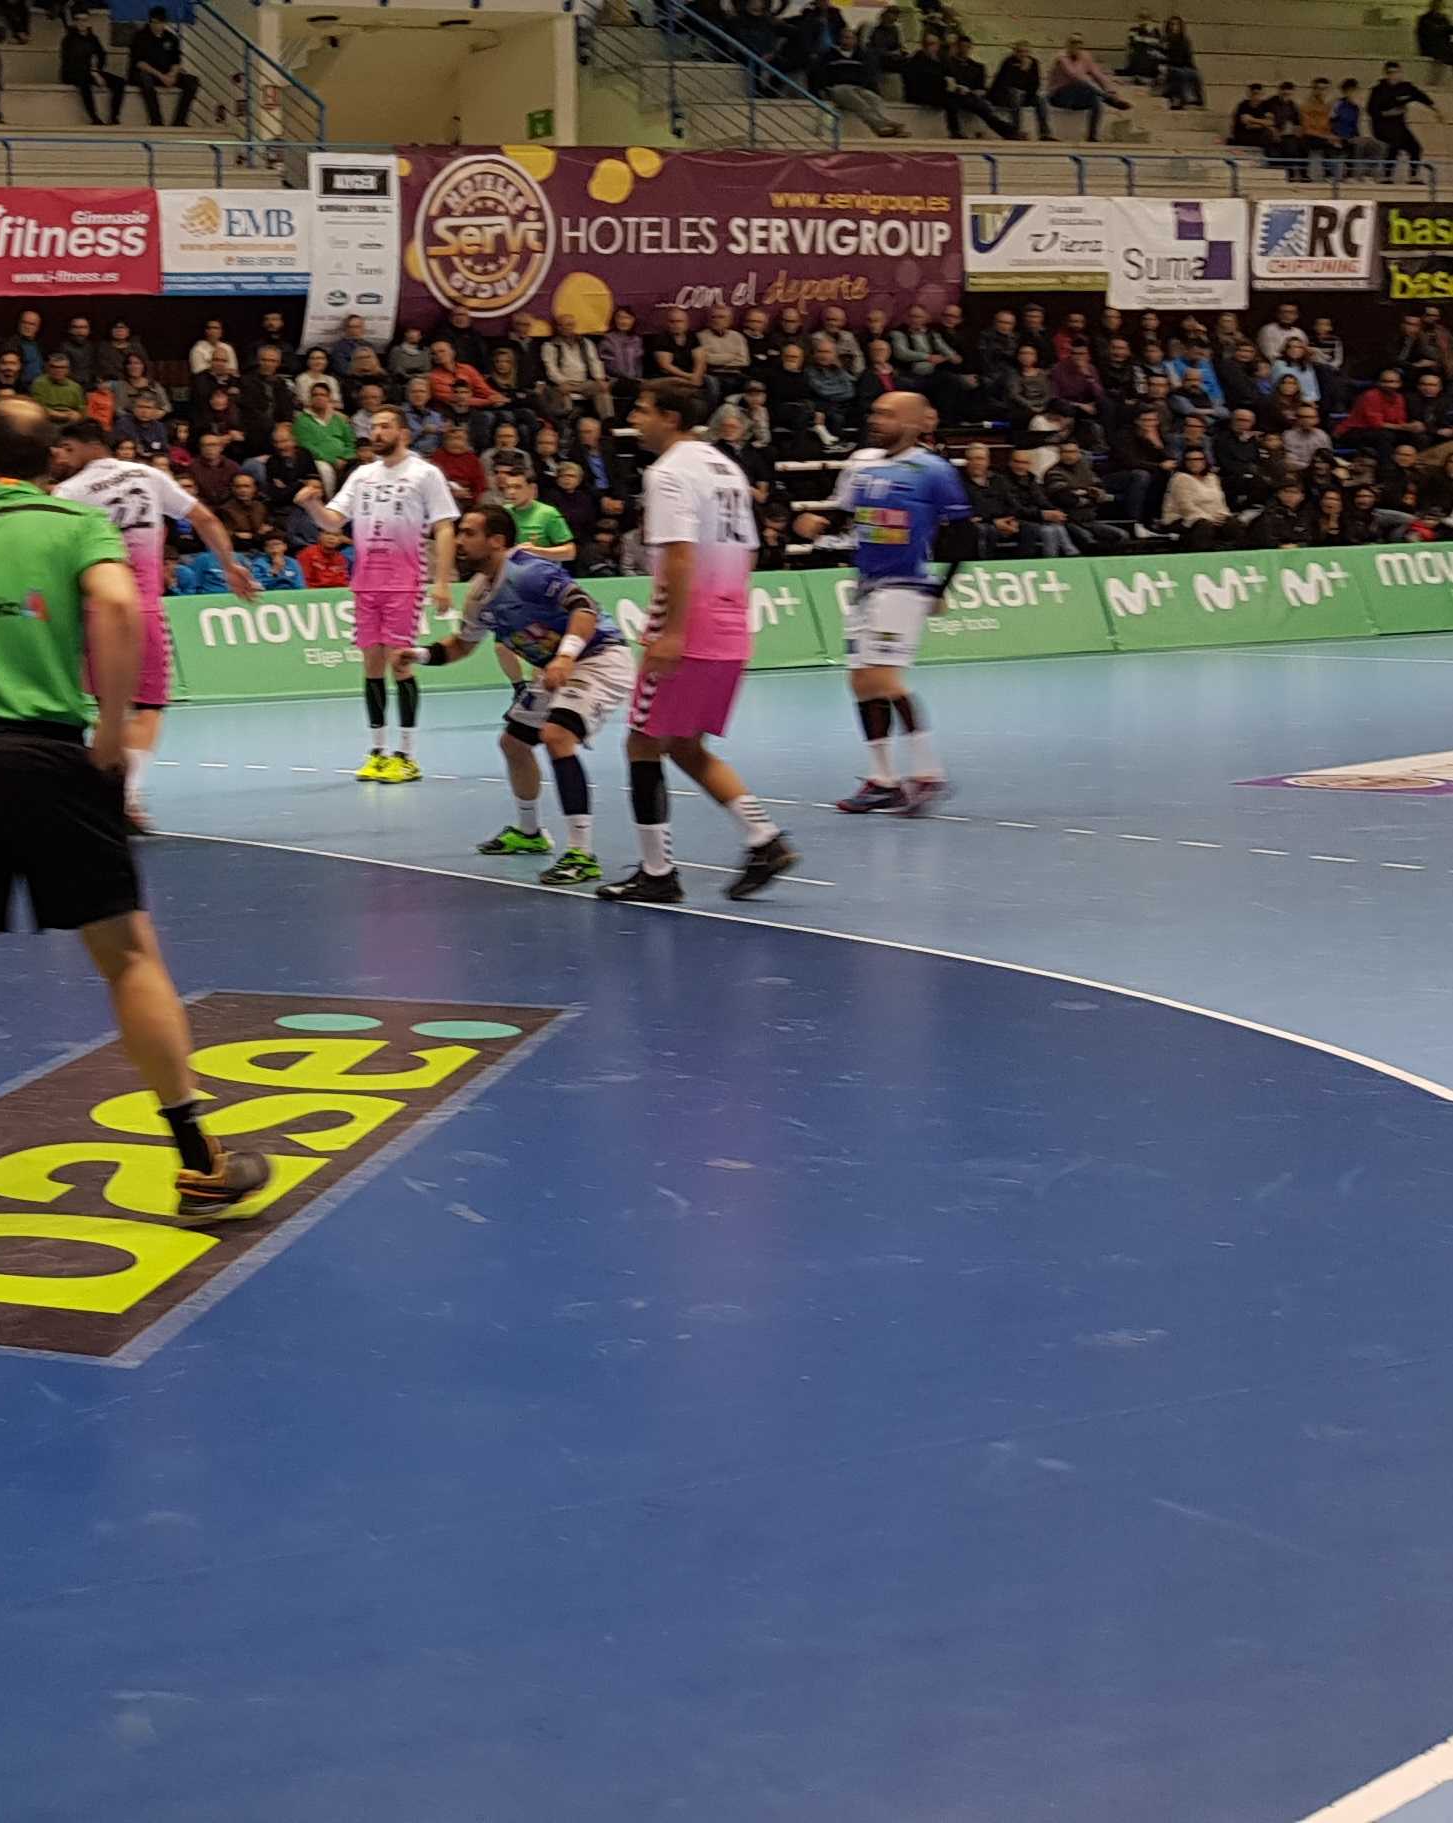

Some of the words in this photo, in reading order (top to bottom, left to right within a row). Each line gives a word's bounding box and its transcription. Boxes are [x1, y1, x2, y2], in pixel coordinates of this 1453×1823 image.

[224, 208, 295, 237] EMB
[561, 216, 717, 254] HOTELES
[728, 217, 950, 257] SERVIGROUP
[1310, 206, 1365, 257] RC
[1122, 248, 1208, 281] Suma
